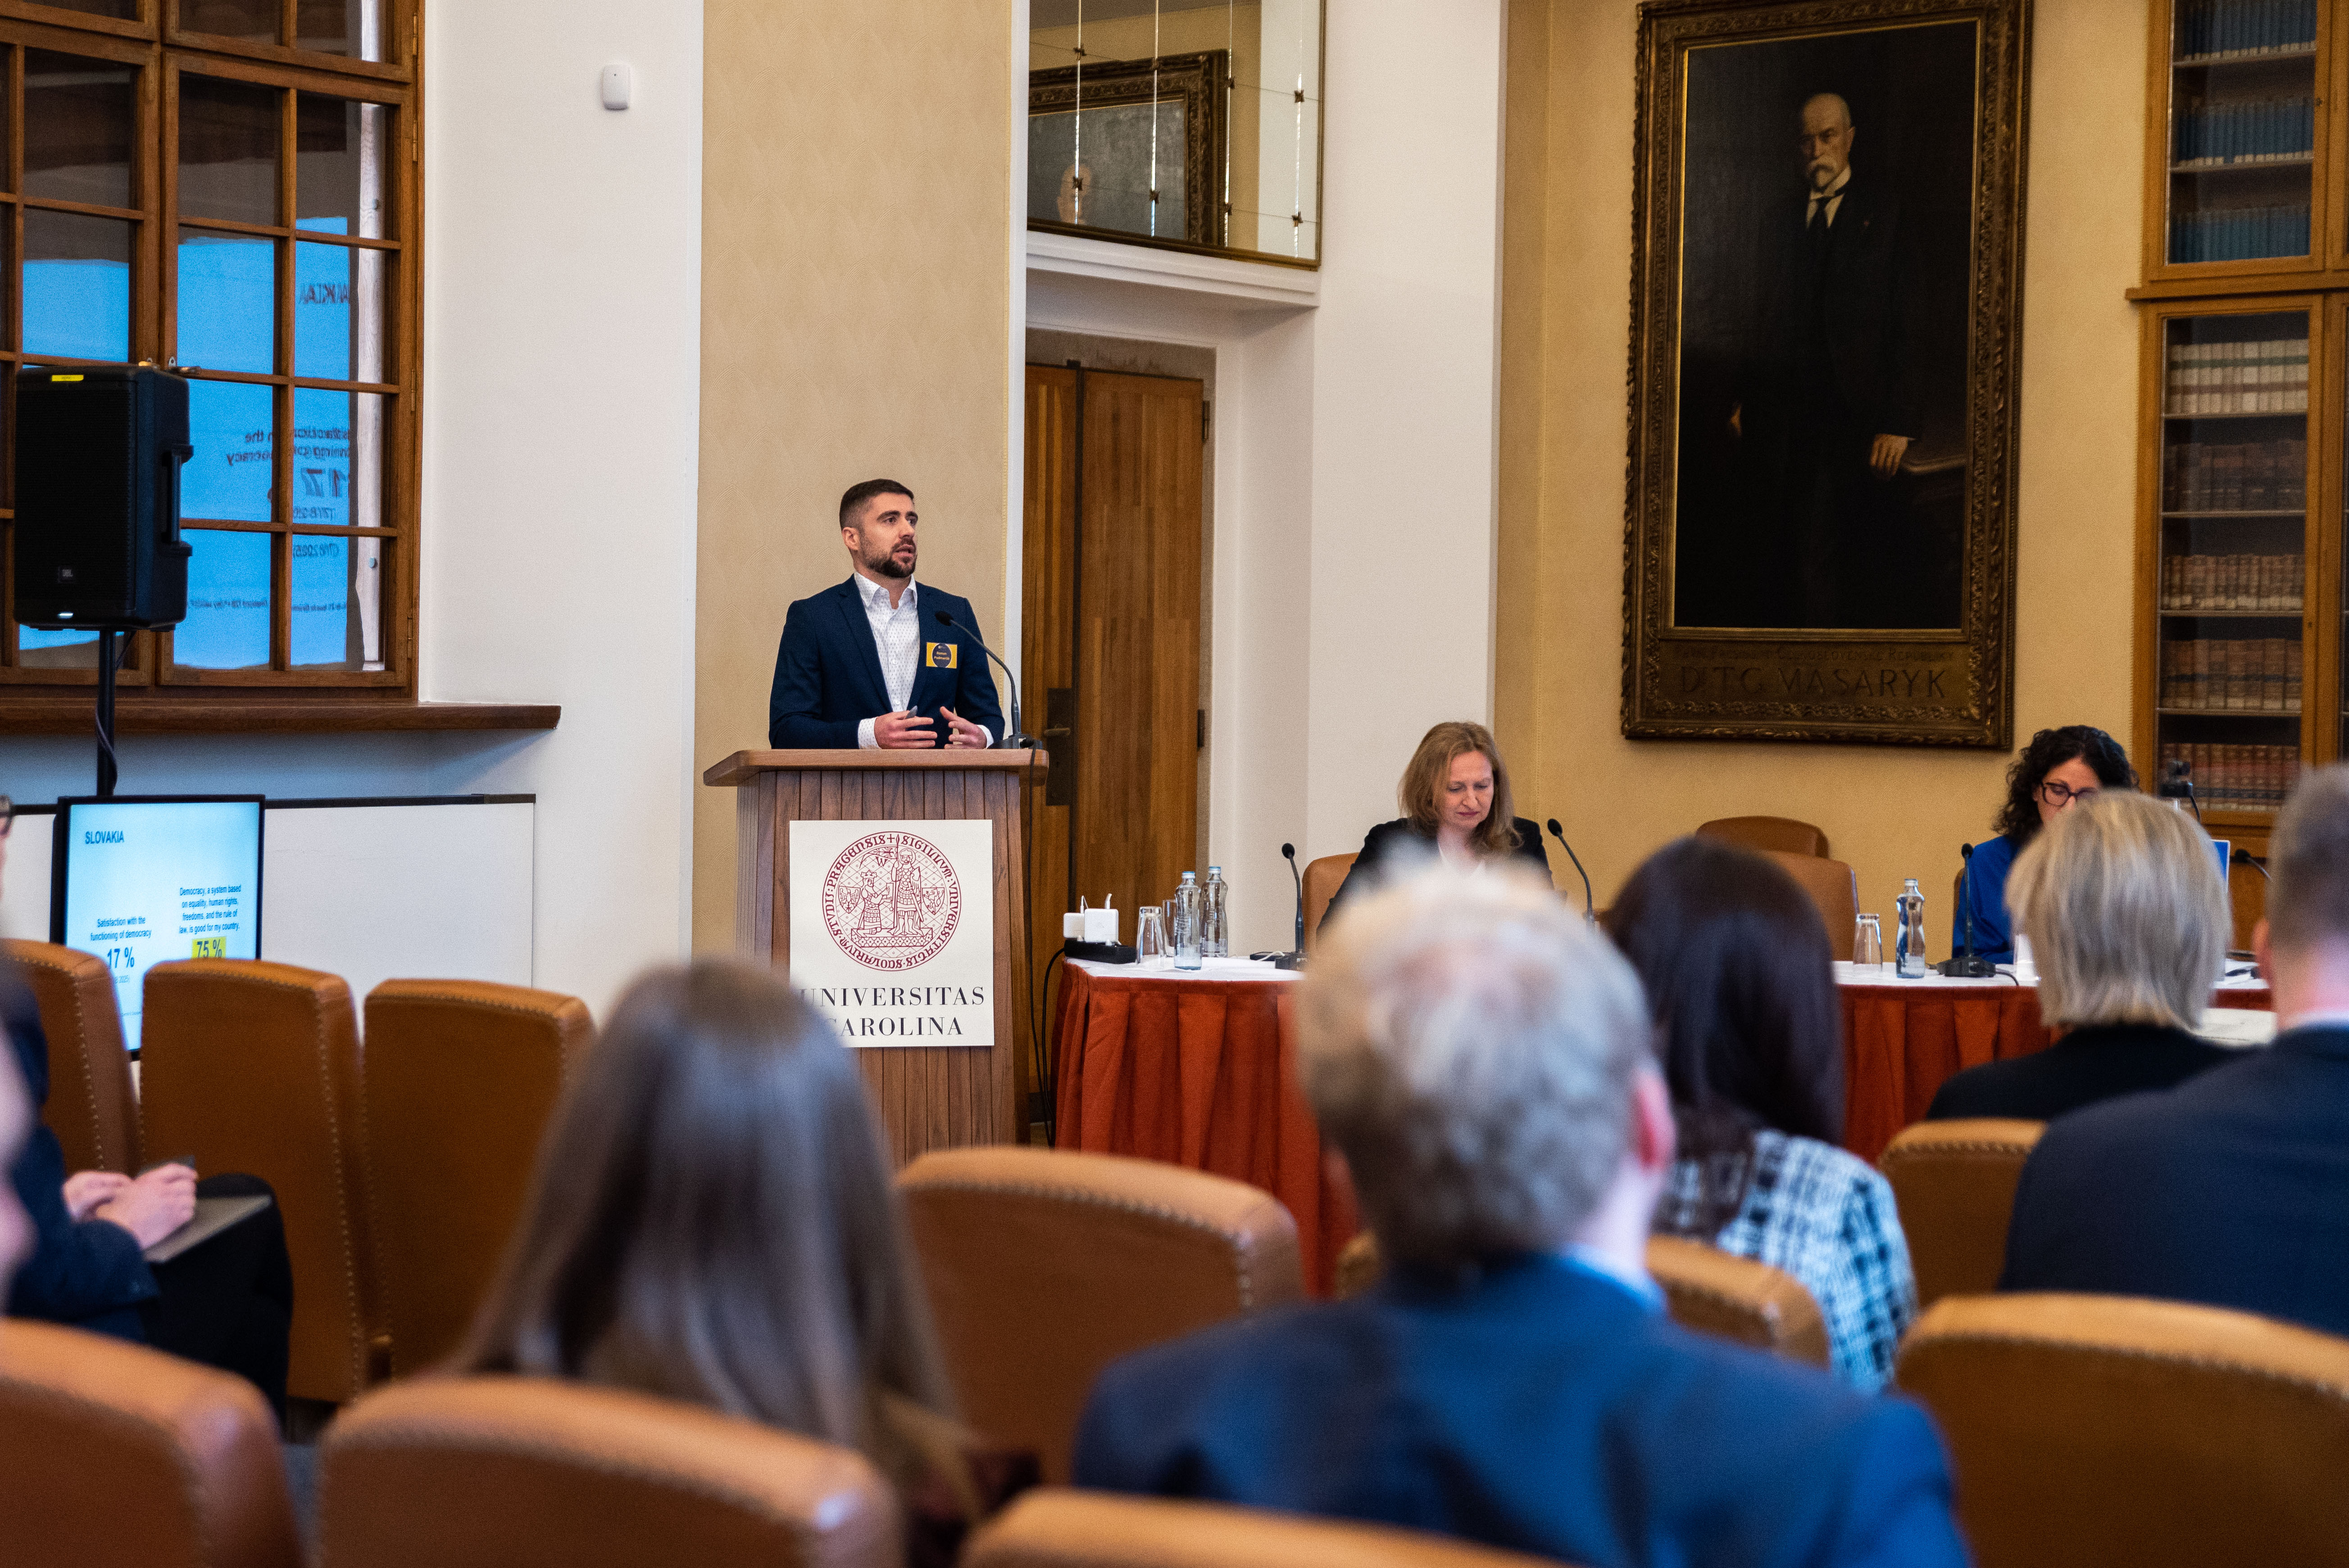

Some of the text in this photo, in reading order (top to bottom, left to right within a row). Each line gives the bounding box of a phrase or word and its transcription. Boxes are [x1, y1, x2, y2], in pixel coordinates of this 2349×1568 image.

[1778, 666, 1946, 698] MASARYK
[85, 831, 124, 844] SLOVAKIA
[180, 887, 206, 896] Democracy,
[211, 886, 227, 895] system
[228, 884, 241, 893] based
[189, 899, 208, 909] equality,
[182, 913, 204, 921] freedoms,
[206, 911, 214, 919] and
[223, 909, 232, 918] rule
[233, 909, 238, 917] of
[97, 918, 126, 927] Satisfaction
[127, 917, 137, 925] with
[179, 926, 188, 934] law,
[195, 923, 206, 935] good
[222, 922, 240, 931] country.
[91, 929, 152, 941] functioning of democracy
[197, 939, 222, 958] 75 %
[107, 946, 134, 968] 17 %
[827, 1017, 963, 1036] AROLINA
